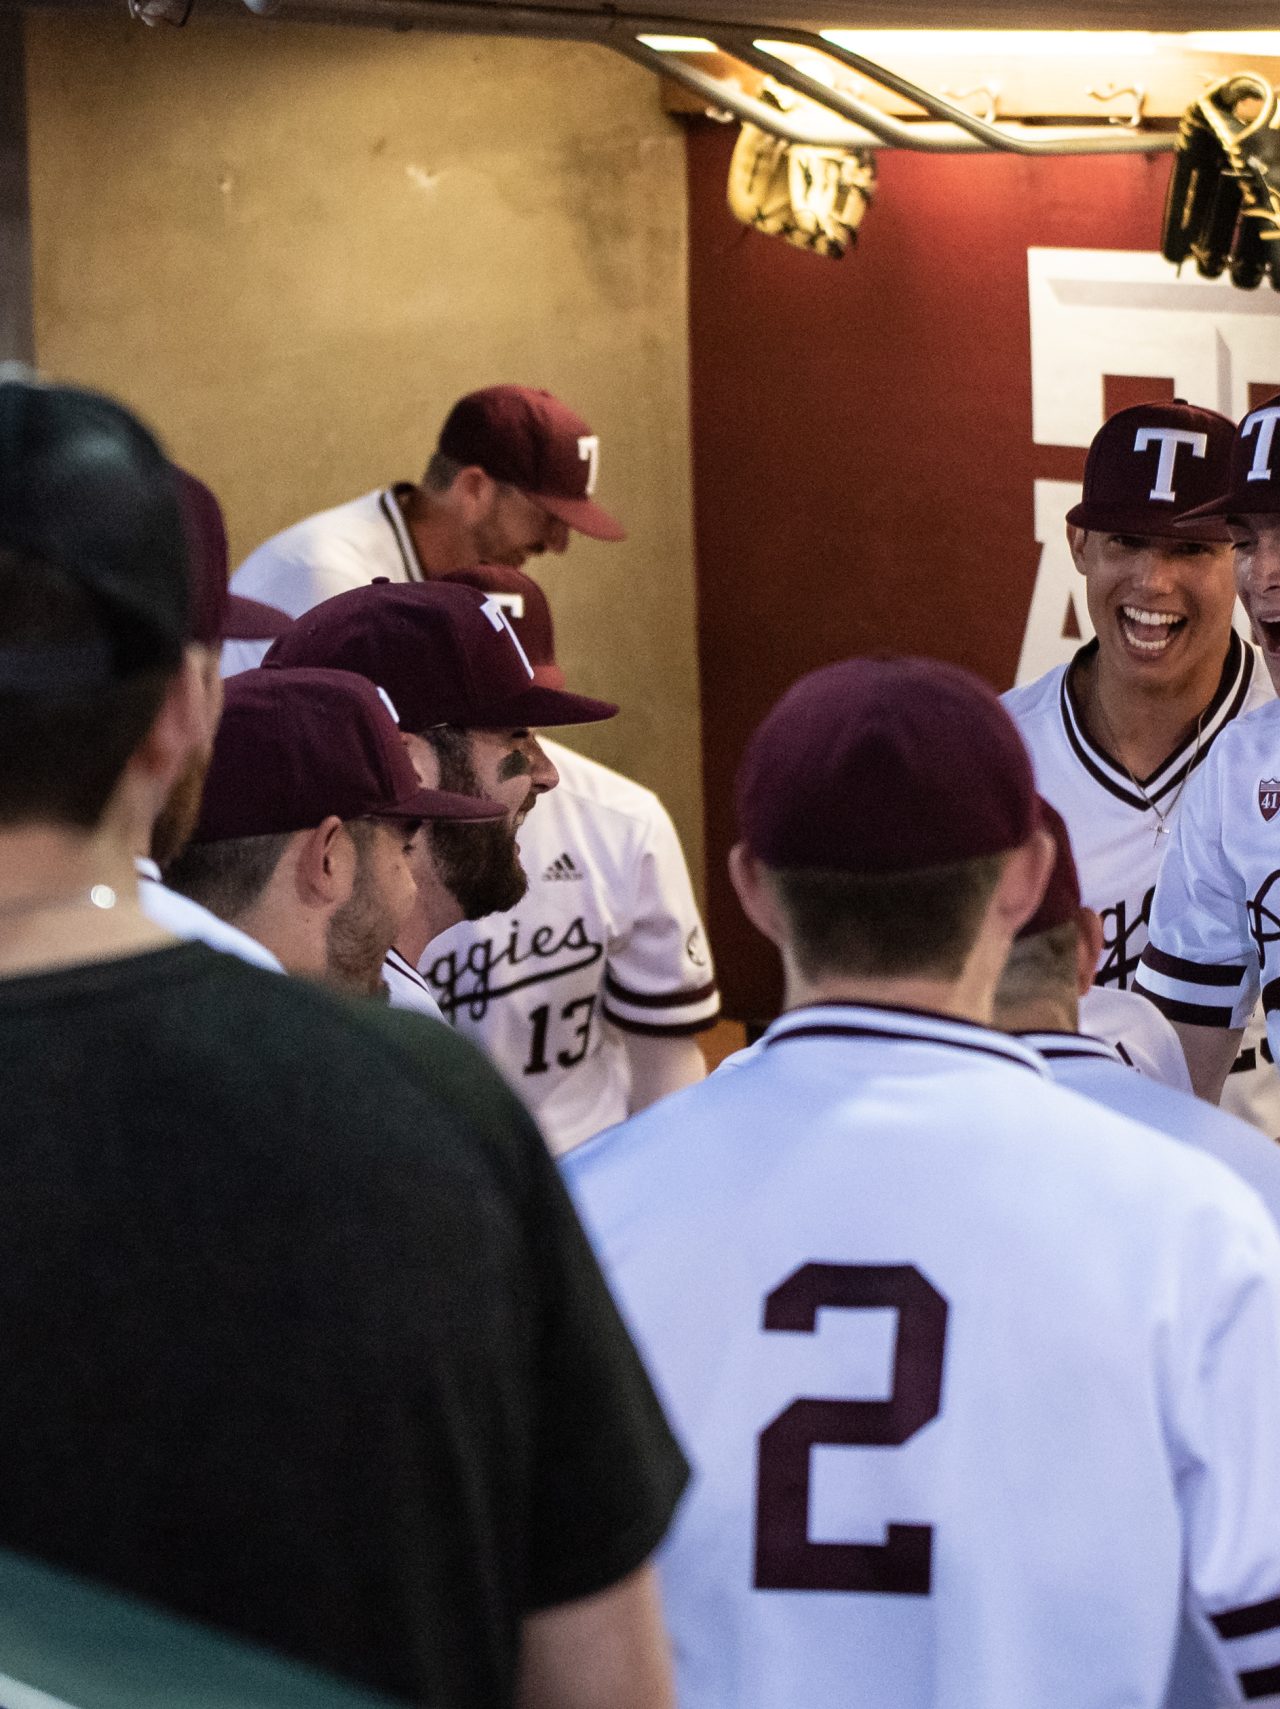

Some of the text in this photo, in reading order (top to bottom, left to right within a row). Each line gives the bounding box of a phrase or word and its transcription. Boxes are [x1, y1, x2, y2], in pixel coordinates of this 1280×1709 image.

[1133, 427, 1207, 502] T
[1260, 792, 1278, 809] 41
[426, 917, 604, 1022] ggies
[523, 996, 599, 1075] 13
[754, 1262, 949, 1595] 2
